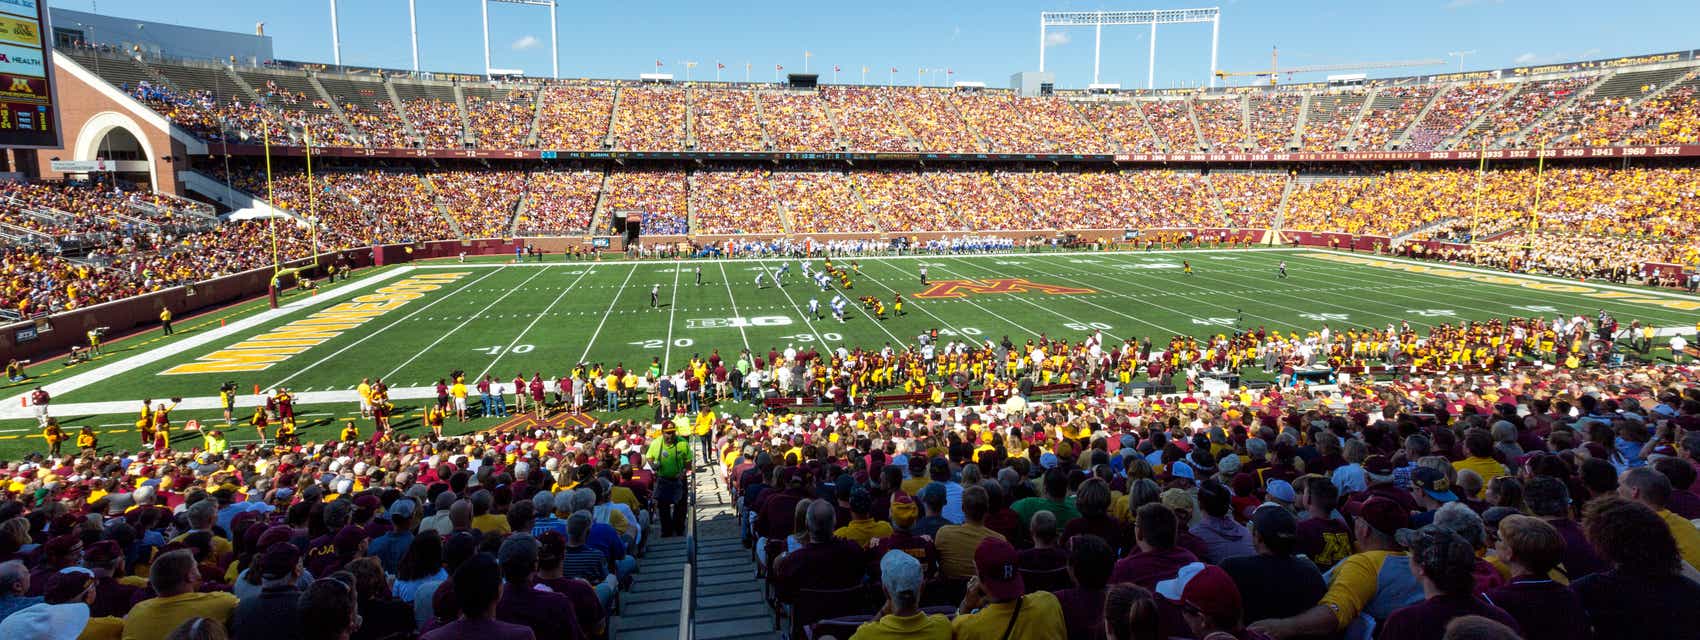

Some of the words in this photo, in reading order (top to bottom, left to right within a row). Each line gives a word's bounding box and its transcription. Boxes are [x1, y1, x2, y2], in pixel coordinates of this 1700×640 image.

[12, 57, 40, 65] HEALTH
[1591, 148, 1614, 156] 1941
[1655, 147, 1681, 155] 1967
[1063, 322, 1113, 331] 50
[938, 327, 982, 336] 40
[794, 332, 843, 342] 30
[643, 338, 694, 349] 20
[486, 343, 536, 356] 10
